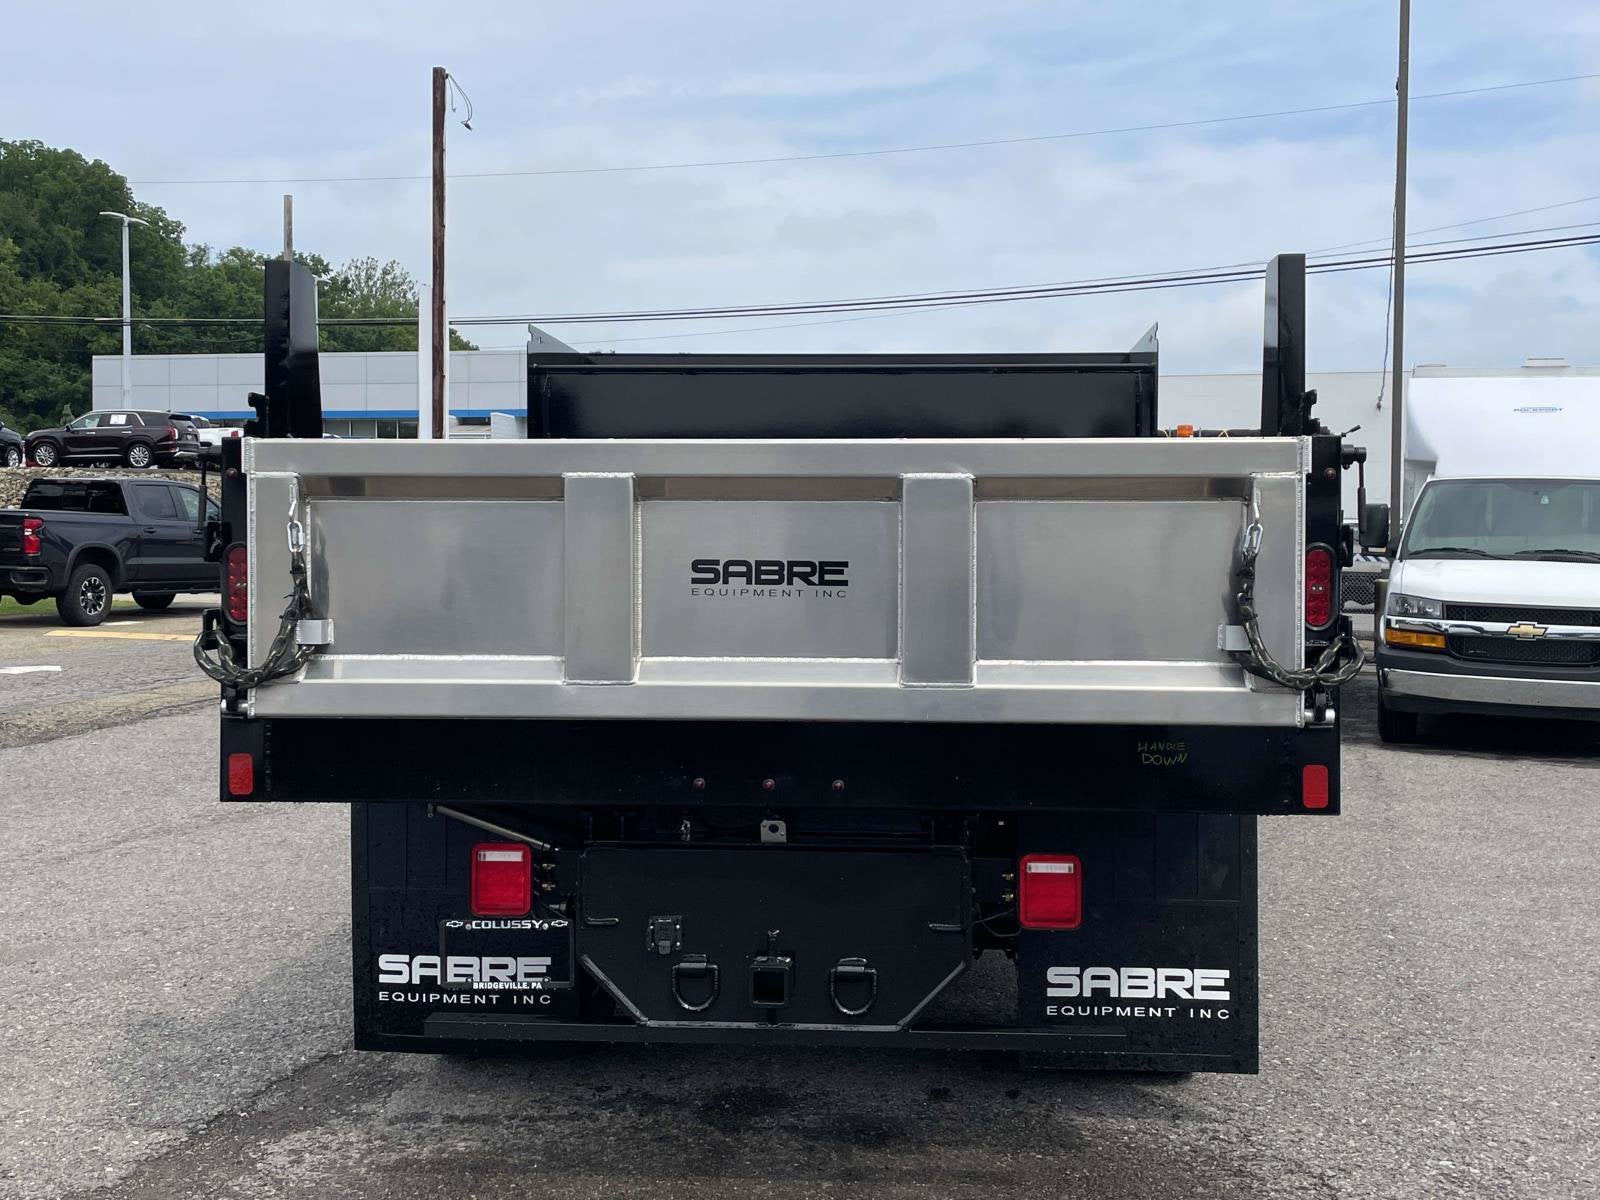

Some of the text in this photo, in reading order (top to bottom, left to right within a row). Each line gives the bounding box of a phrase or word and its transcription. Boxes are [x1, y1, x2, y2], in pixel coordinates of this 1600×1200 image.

[691, 559, 849, 586] SABRE
[691, 588, 847, 598] EQUIPMENT INC
[1142, 753, 1188, 765] DOWN
[472, 920, 543, 929] COLUSSY
[378, 954, 552, 985] SABRE
[1046, 966, 1231, 1000] SABRE
[378, 991, 551, 1005] EQUIPMENT INC
[1046, 1005, 1230, 1019] EQUIPMENT INC
